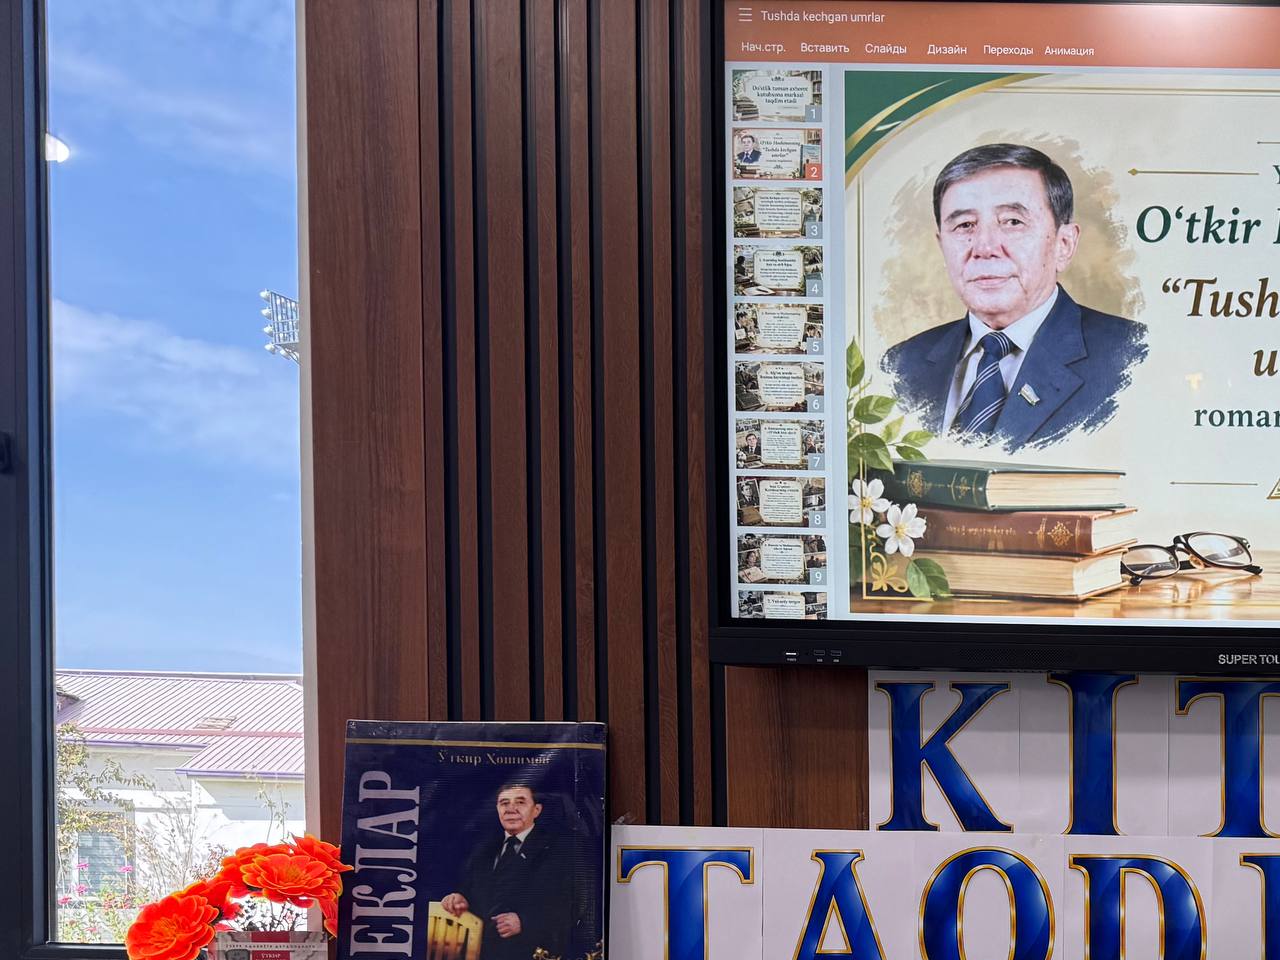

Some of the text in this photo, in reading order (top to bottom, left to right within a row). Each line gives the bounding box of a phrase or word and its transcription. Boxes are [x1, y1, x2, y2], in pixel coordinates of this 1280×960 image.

[761, 10, 886, 24] Tushda kechgan umrlar
[741, 42, 786, 54] Нач.стр.
[800, 42, 850, 53] Вставить
[865, 43, 907, 55] Слайды
[927, 44, 967, 55] Дизайн
[983, 45, 1034, 56] Переходы
[1044, 46, 1095, 57] Анимация
[1218, 653, 1258, 665] SUPER
